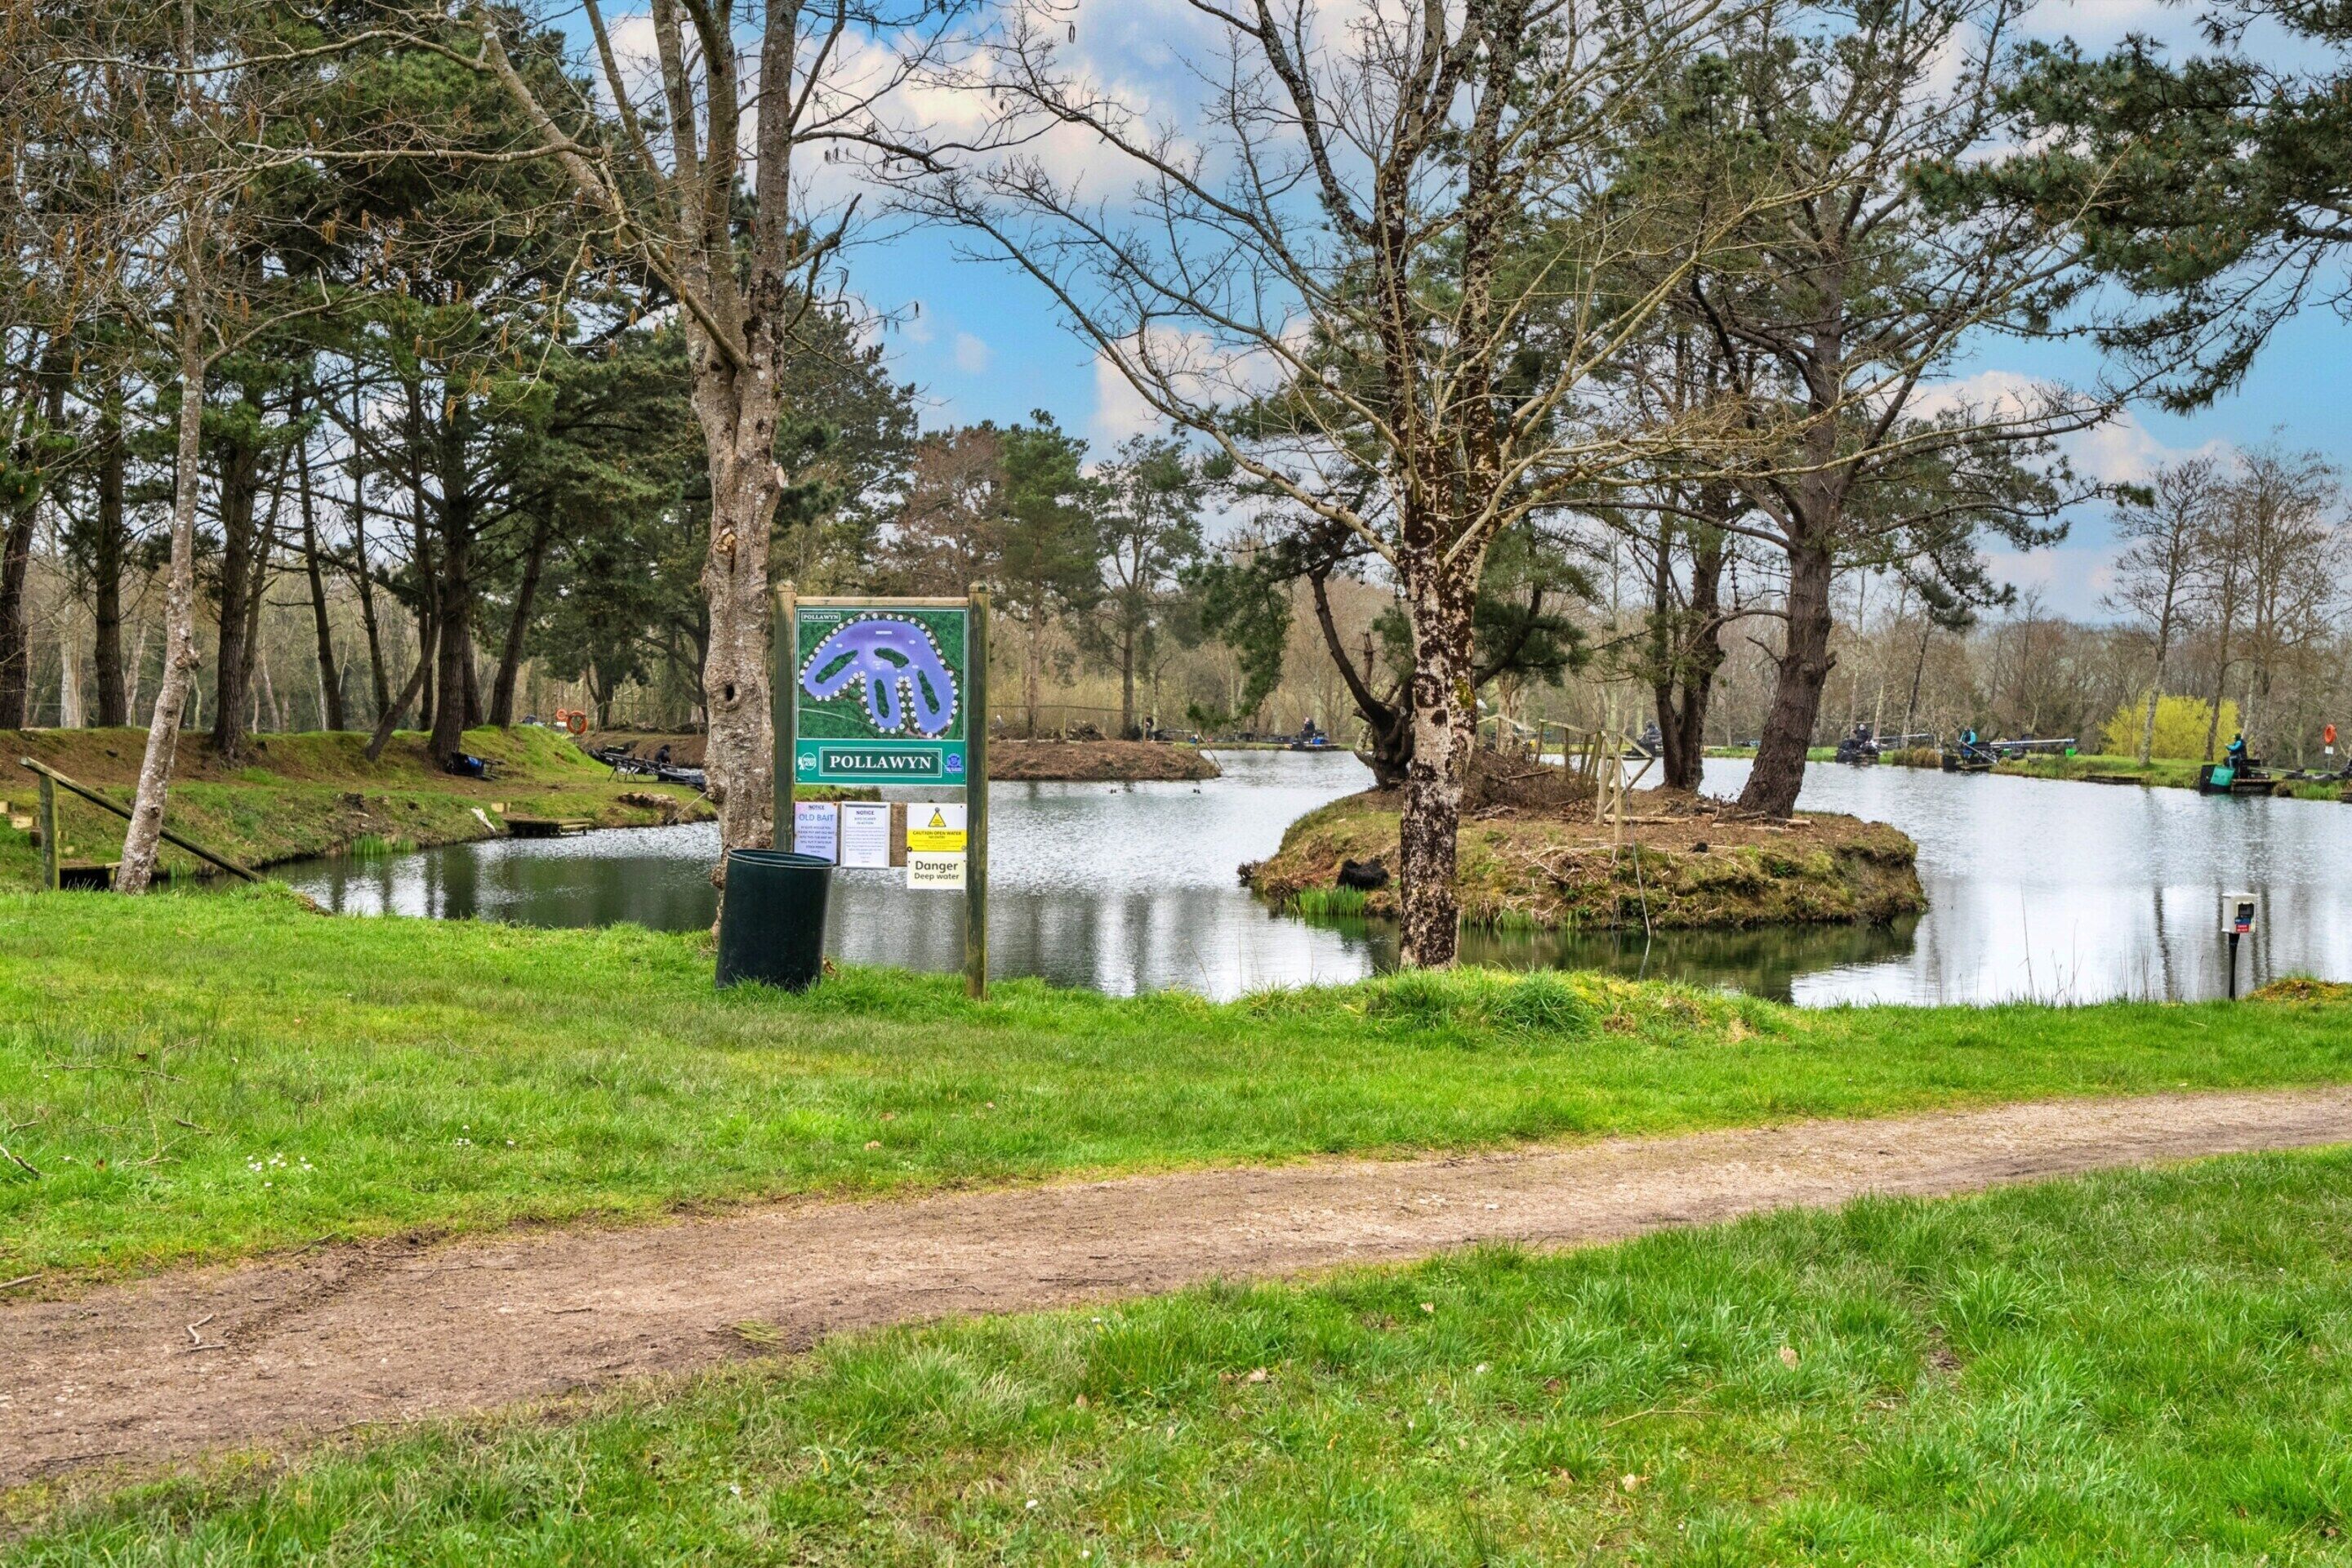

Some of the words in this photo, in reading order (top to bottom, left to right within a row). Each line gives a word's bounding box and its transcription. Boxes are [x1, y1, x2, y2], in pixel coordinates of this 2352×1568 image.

[830, 755, 932, 768] POLLAWYN
[915, 861, 958, 873] Danger
[915, 873, 934, 881] Deep
